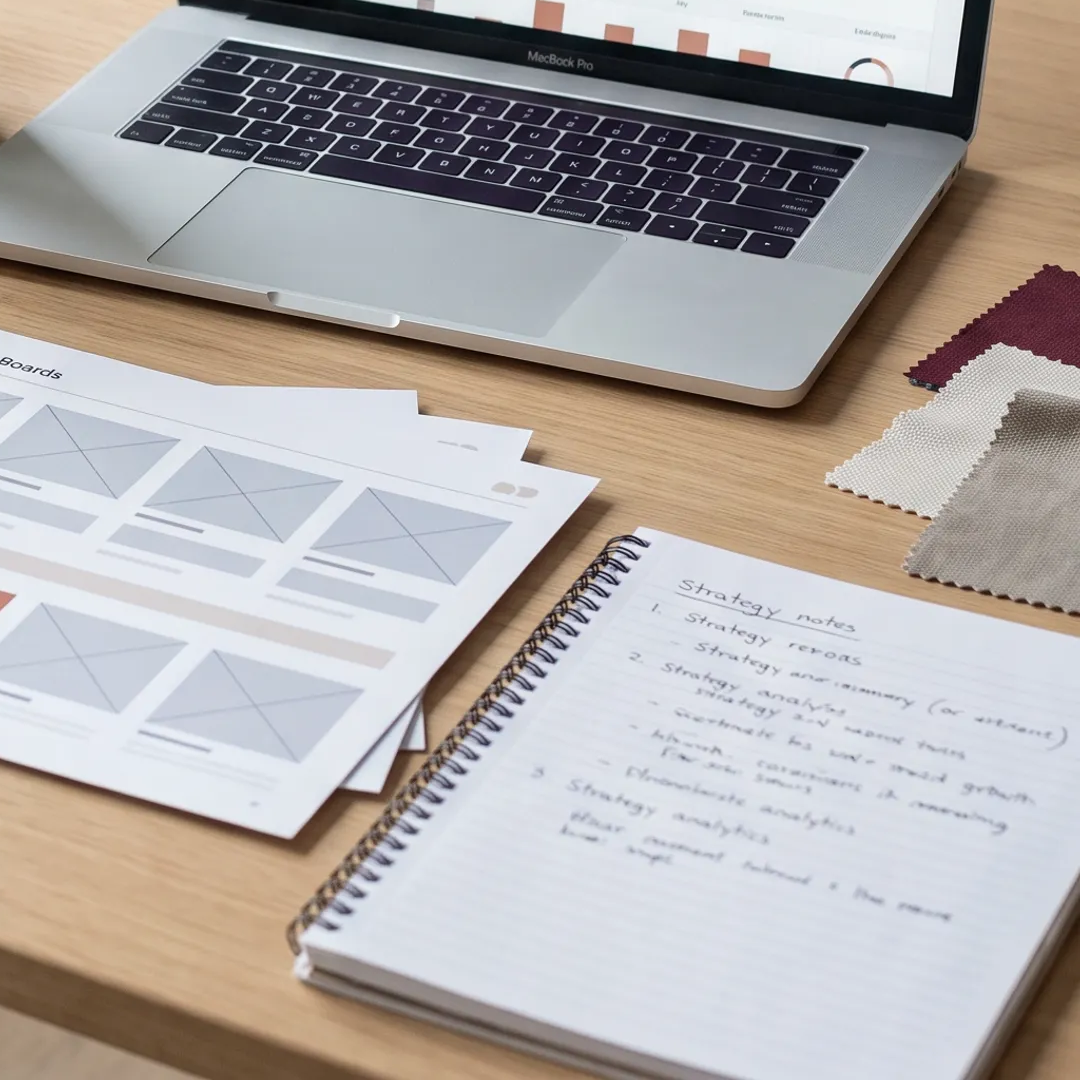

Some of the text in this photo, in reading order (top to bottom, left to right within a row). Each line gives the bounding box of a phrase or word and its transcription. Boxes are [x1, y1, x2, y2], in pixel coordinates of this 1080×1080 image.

[576, 58, 594, 72] Pro
[678, 579, 856, 633] Strategy notes
[684, 612, 772, 646] Strategy
[694, 642, 782, 676] Strategy
[662, 662, 742, 693] Strategy
[565, 778, 657, 818] Strategy
